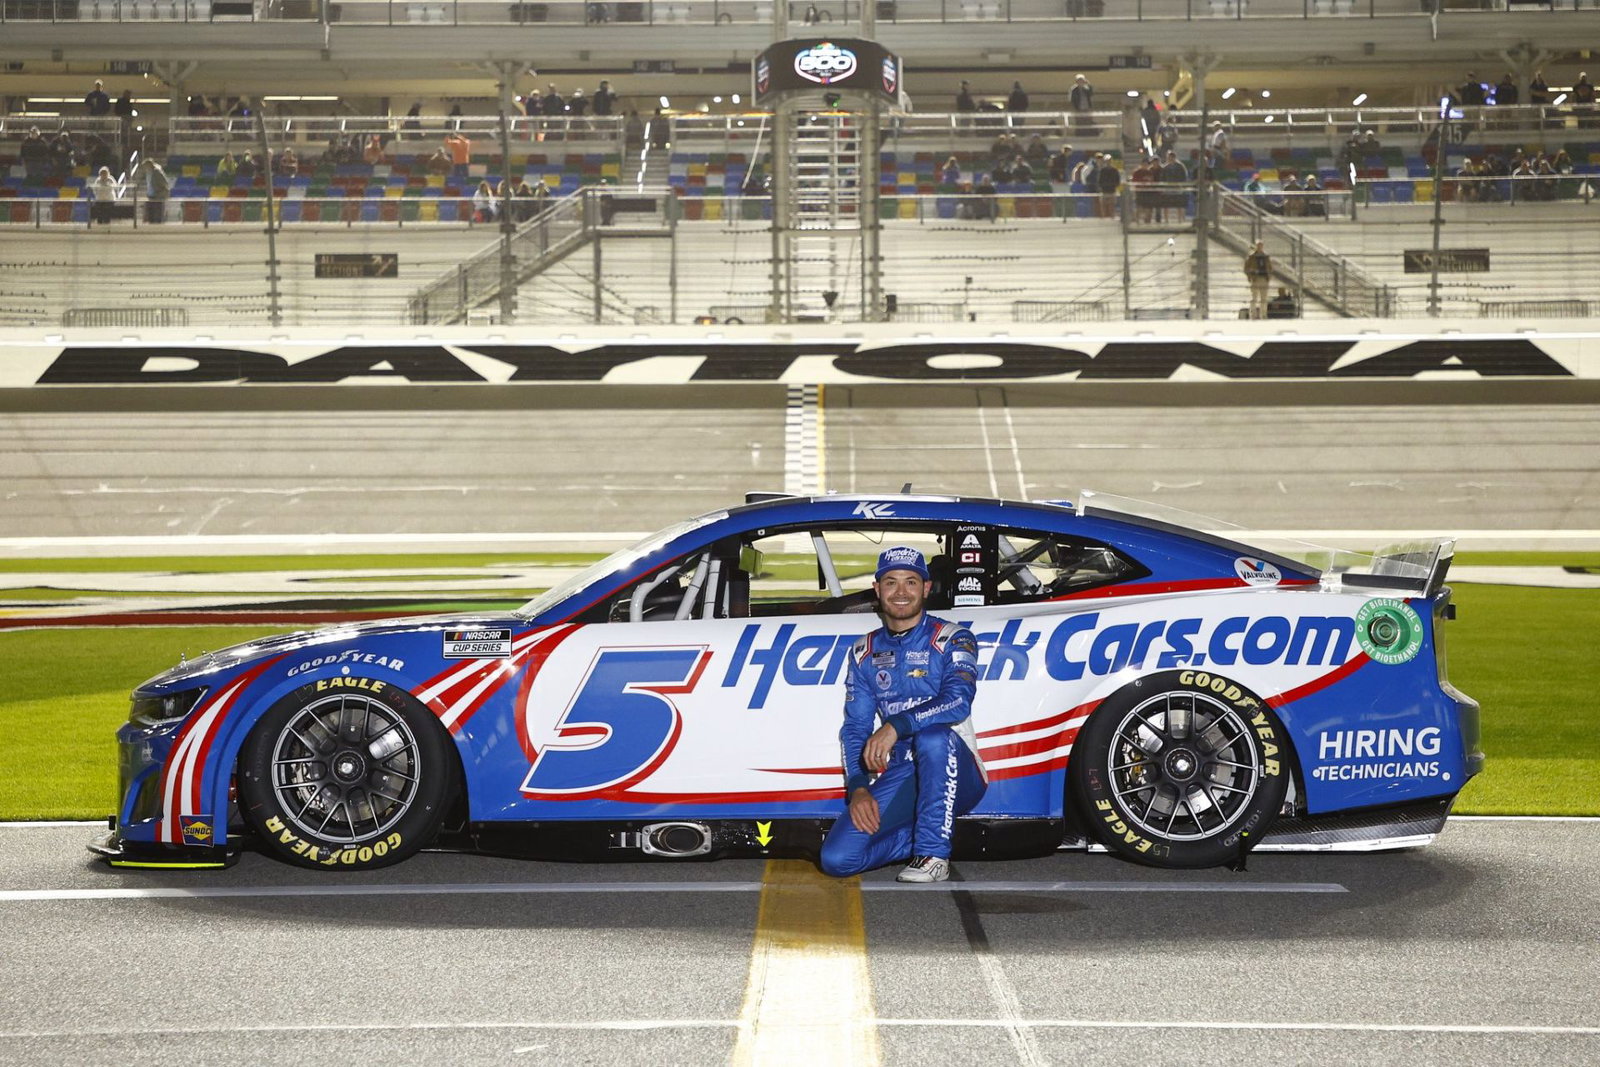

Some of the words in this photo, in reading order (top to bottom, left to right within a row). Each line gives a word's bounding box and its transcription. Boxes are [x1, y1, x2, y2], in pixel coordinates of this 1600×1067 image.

[34, 340, 1575, 384] DAYTONA
[958, 576, 982, 587] MAC
[1358, 606, 1371, 621] GET
[1369, 598, 1418, 622] BIOETHANOL
[452, 643, 472, 652] CUP
[471, 643, 502, 652] SERIES
[464, 631, 502, 640] NASCAR
[287, 649, 405, 677] GOODYEAR
[1361, 640, 1376, 655] GET
[1374, 640, 1420, 664] BIOETHANOL
[316, 676, 387, 694] EAGLE
[519, 645, 714, 797] 5
[1179, 670, 1280, 776] GOODYEAR
[1319, 727, 1441, 760] HIRING
[1318, 761, 1439, 781] TECHNICIANS
[1095, 799, 1153, 853] EAGLE
[265, 814, 402, 866] GOODYEAR
